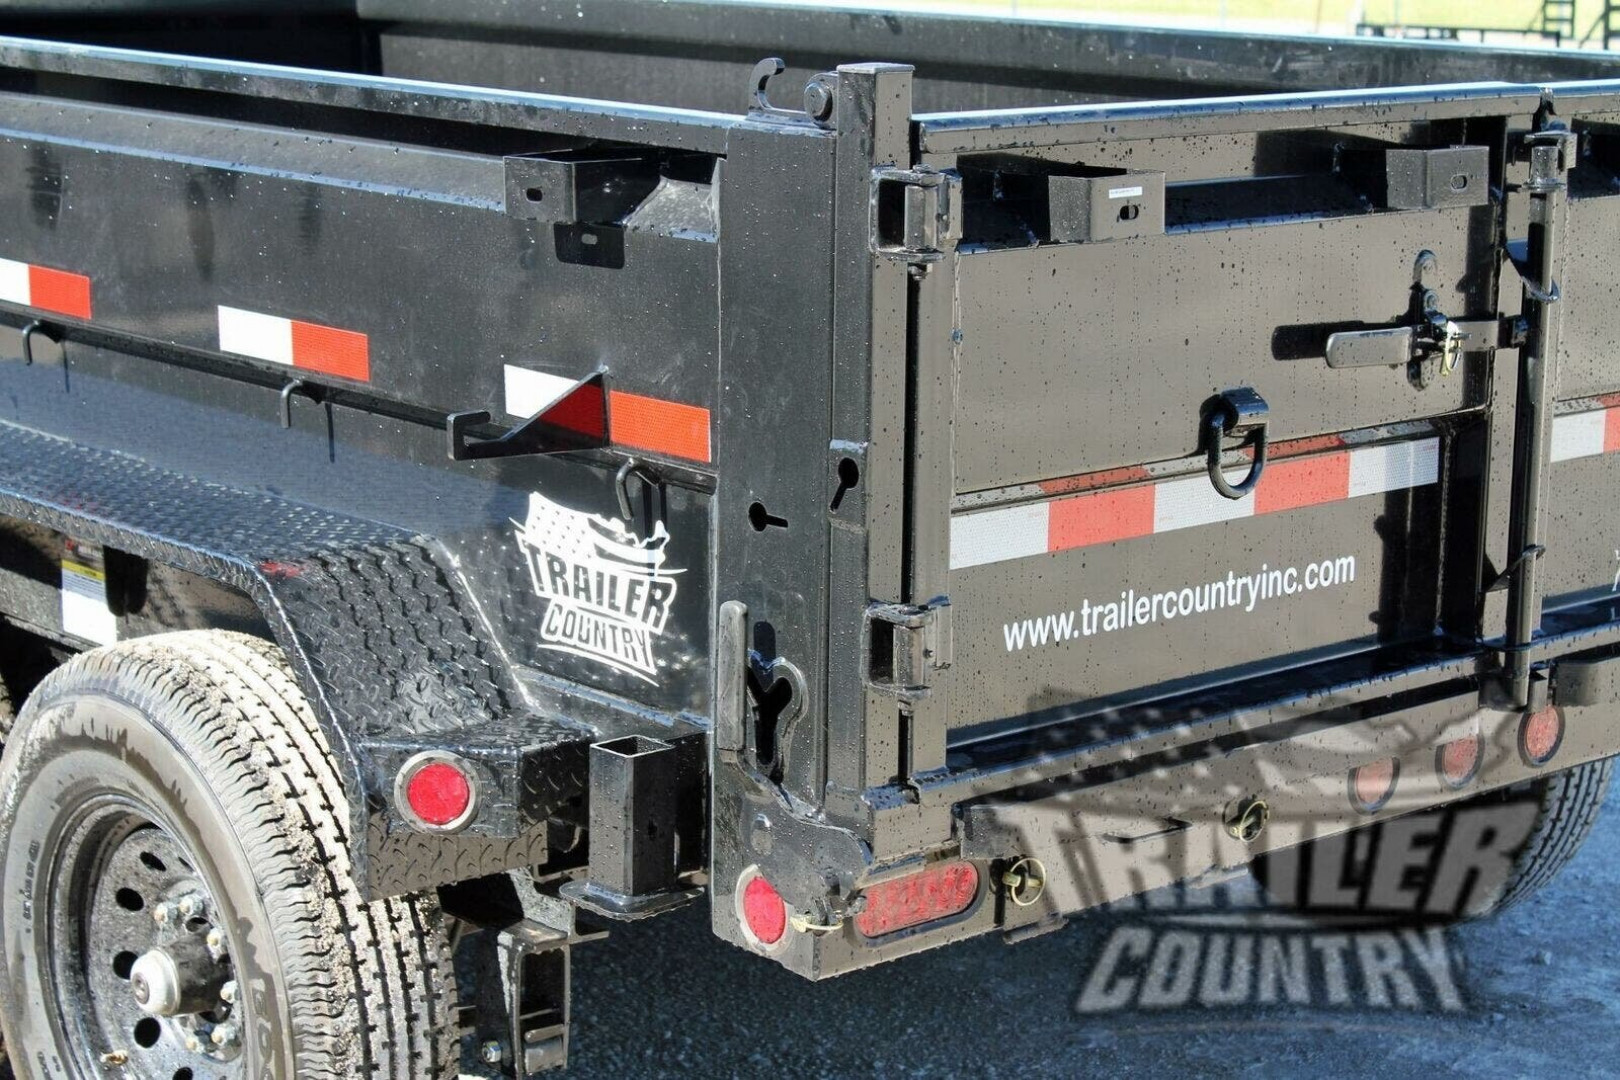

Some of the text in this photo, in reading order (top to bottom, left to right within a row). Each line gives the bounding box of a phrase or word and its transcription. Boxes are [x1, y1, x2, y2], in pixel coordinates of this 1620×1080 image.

[521, 538, 673, 629] TRAILER
[1003, 555, 1355, 652] www.trailercountryinc.com
[544, 603, 651, 667] COUNTRY
